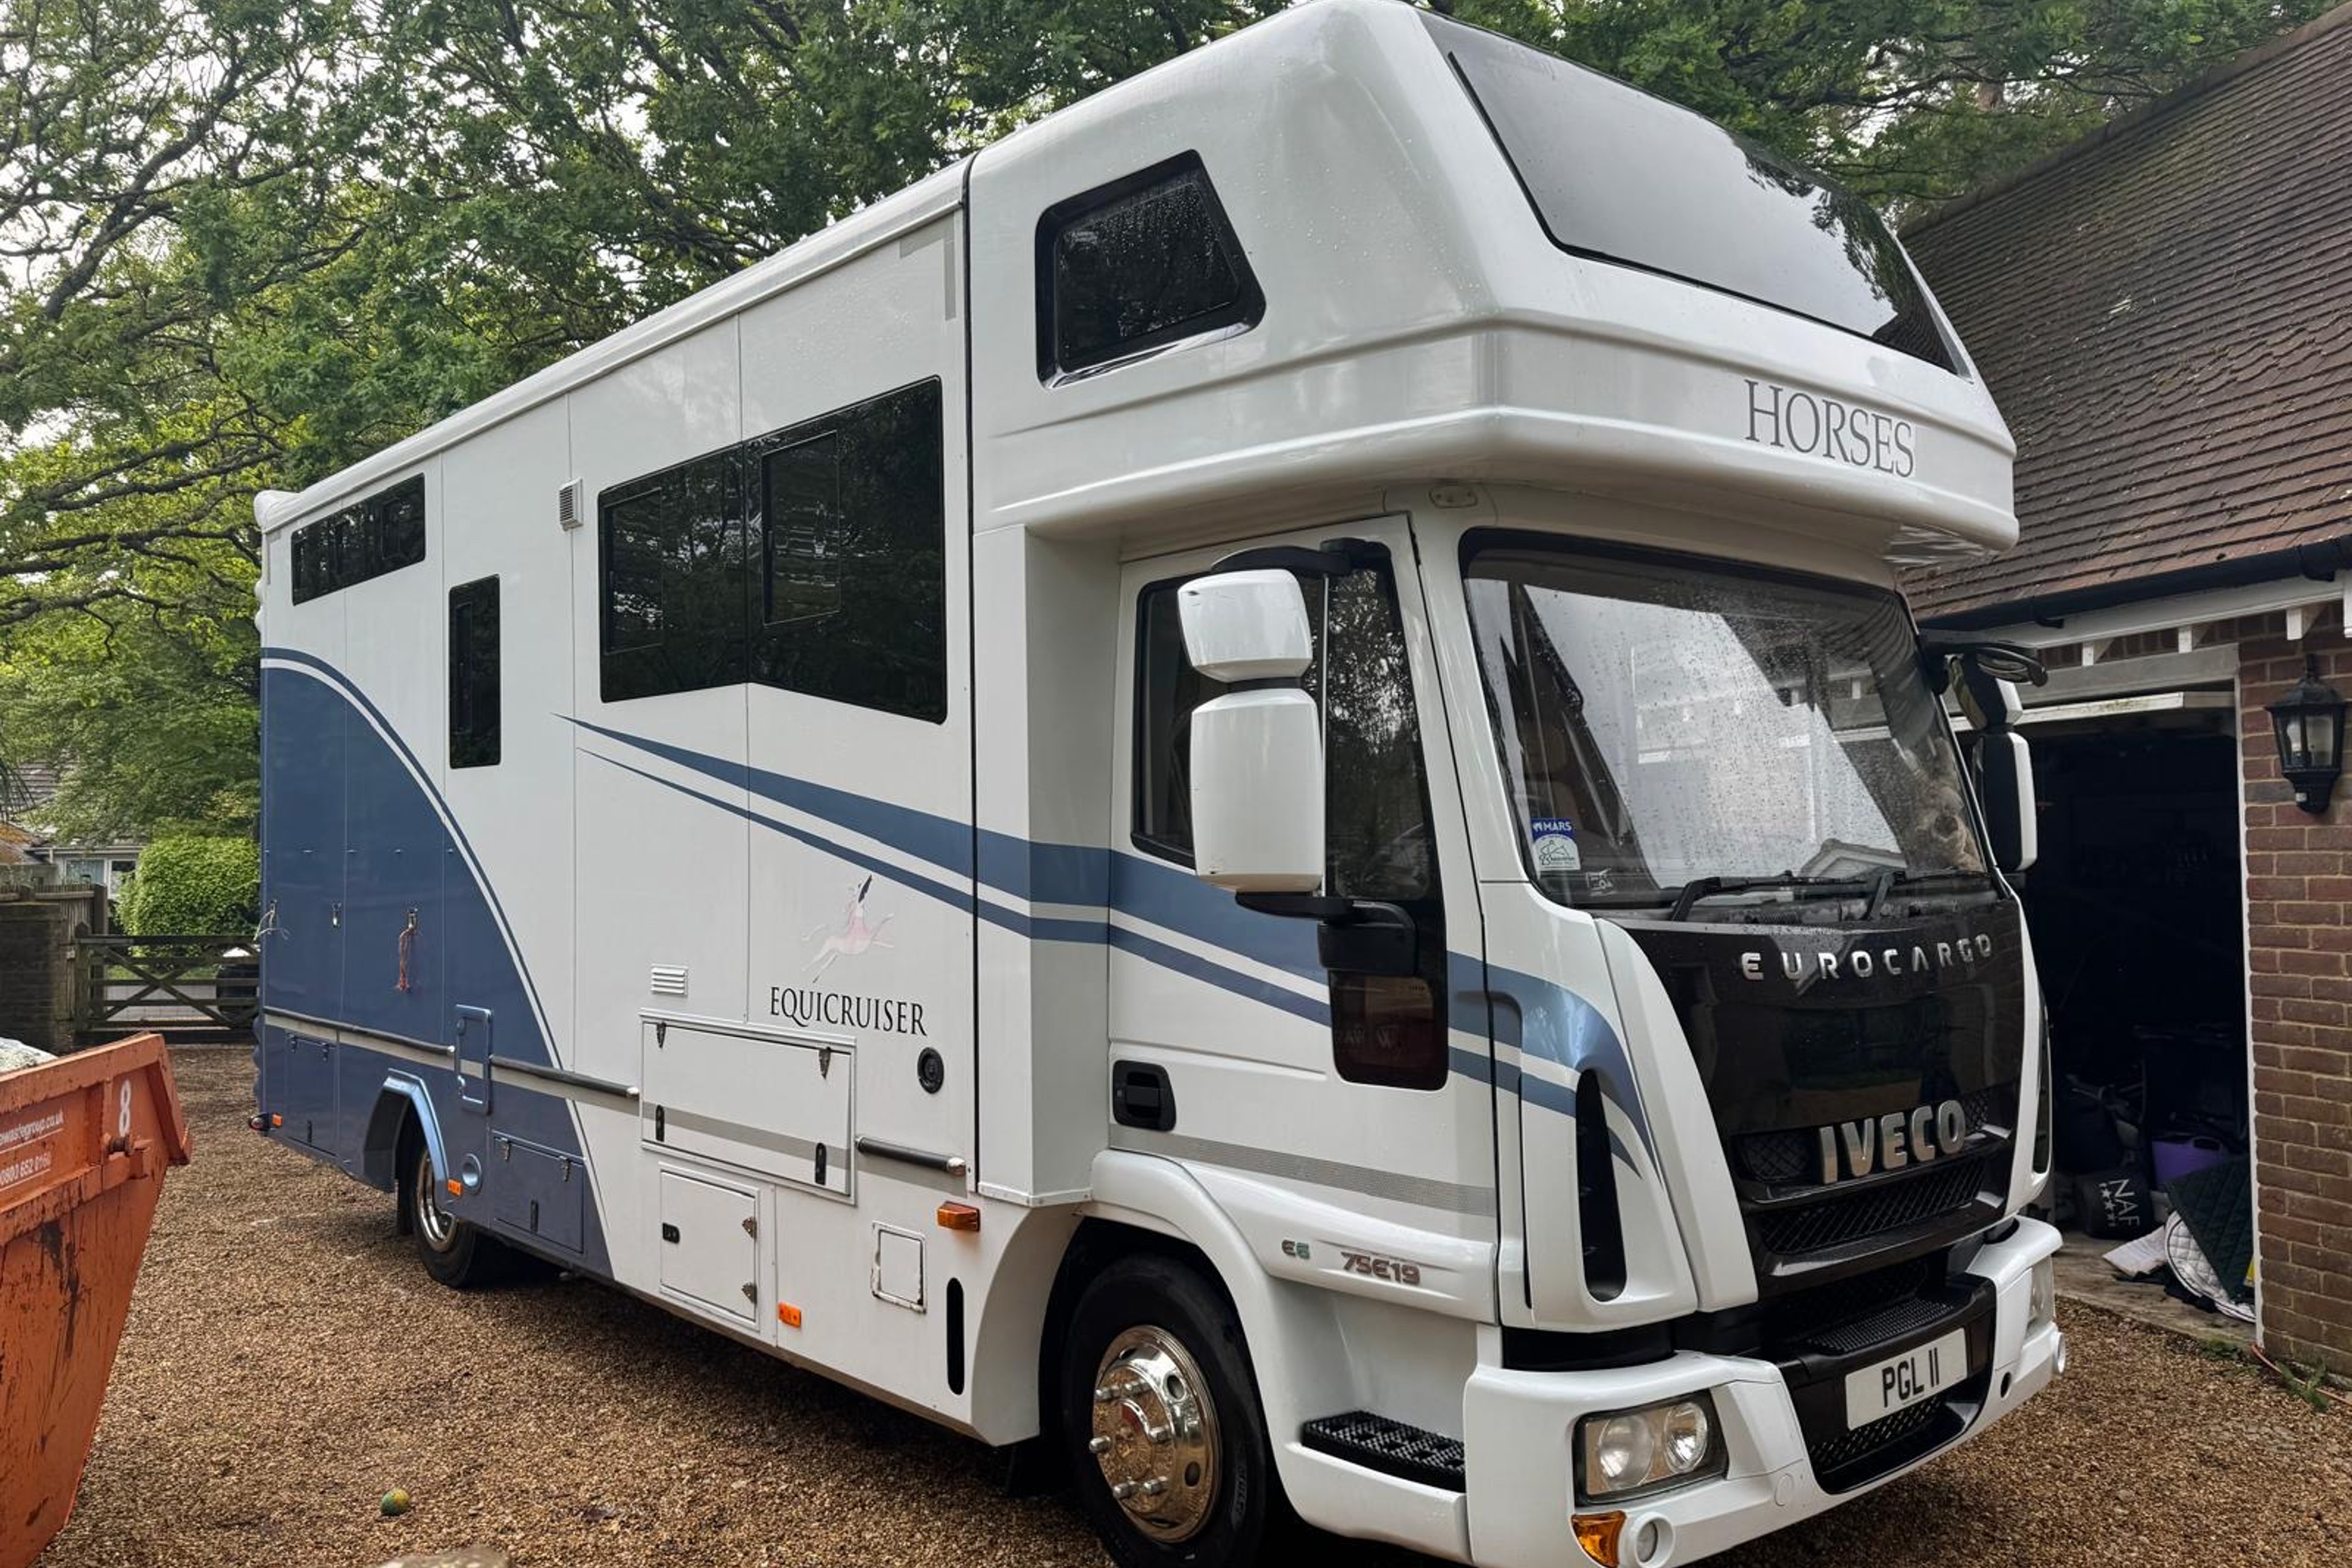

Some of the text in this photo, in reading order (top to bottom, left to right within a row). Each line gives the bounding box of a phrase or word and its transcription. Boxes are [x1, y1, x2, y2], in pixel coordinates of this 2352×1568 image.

[1744, 379, 1913, 477] HORSES
[1543, 821, 1572, 831] MARS
[1741, 933, 1992, 981] EUROCARGO
[770, 986, 927, 1036] EQUICRUISER
[118, 1079, 131, 1137] 8
[1819, 1099, 1966, 1185] IVECO
[2109, 1178, 2141, 1226] NAF
[1341, 1251, 1421, 1286] 75E19
[1882, 1347, 1940, 1408] PGL 11
